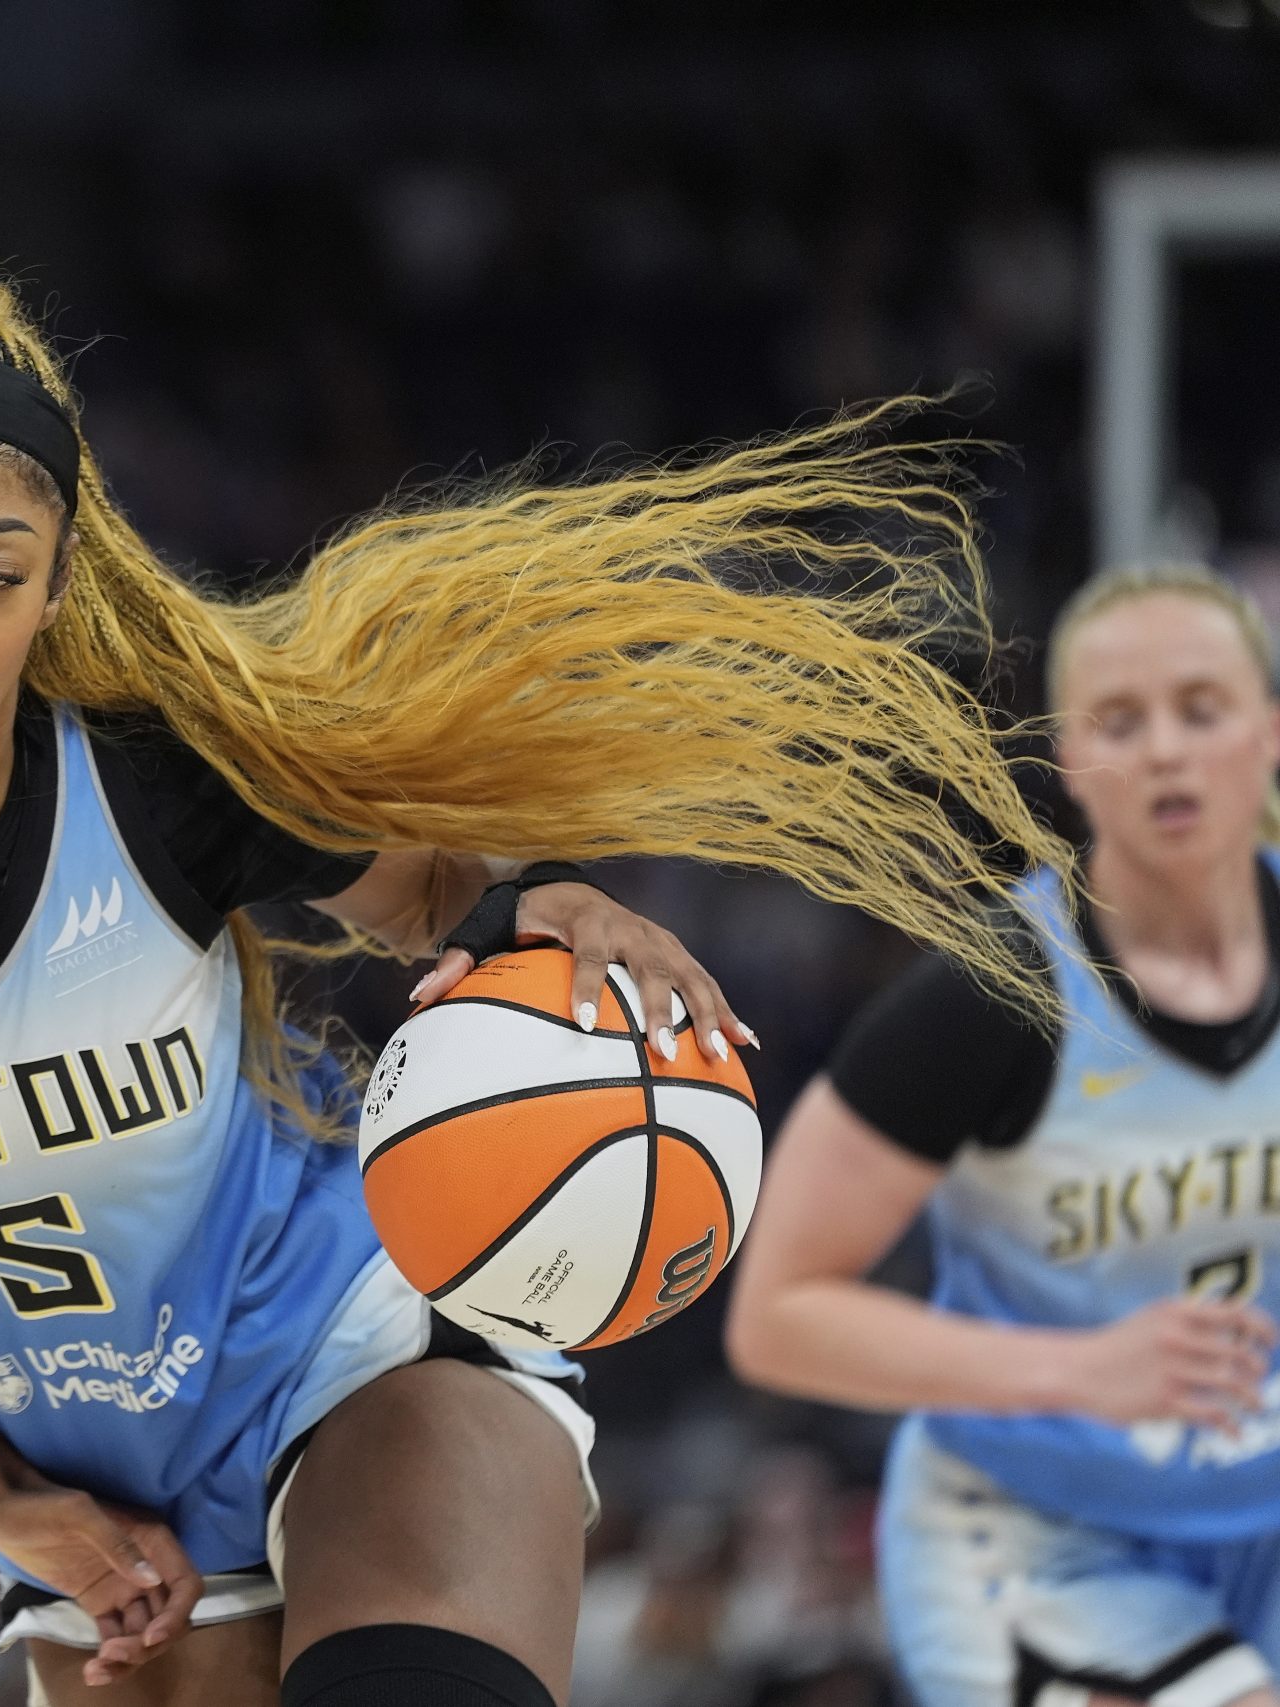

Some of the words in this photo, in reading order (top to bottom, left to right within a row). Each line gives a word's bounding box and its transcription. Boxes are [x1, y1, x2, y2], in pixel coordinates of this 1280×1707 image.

[537, 1261, 574, 1304] OFFICIAL
[541, 1249, 568, 1283] GAME
[521, 1282, 546, 1305] BALL
[41, 1334, 205, 1414] Medicine
